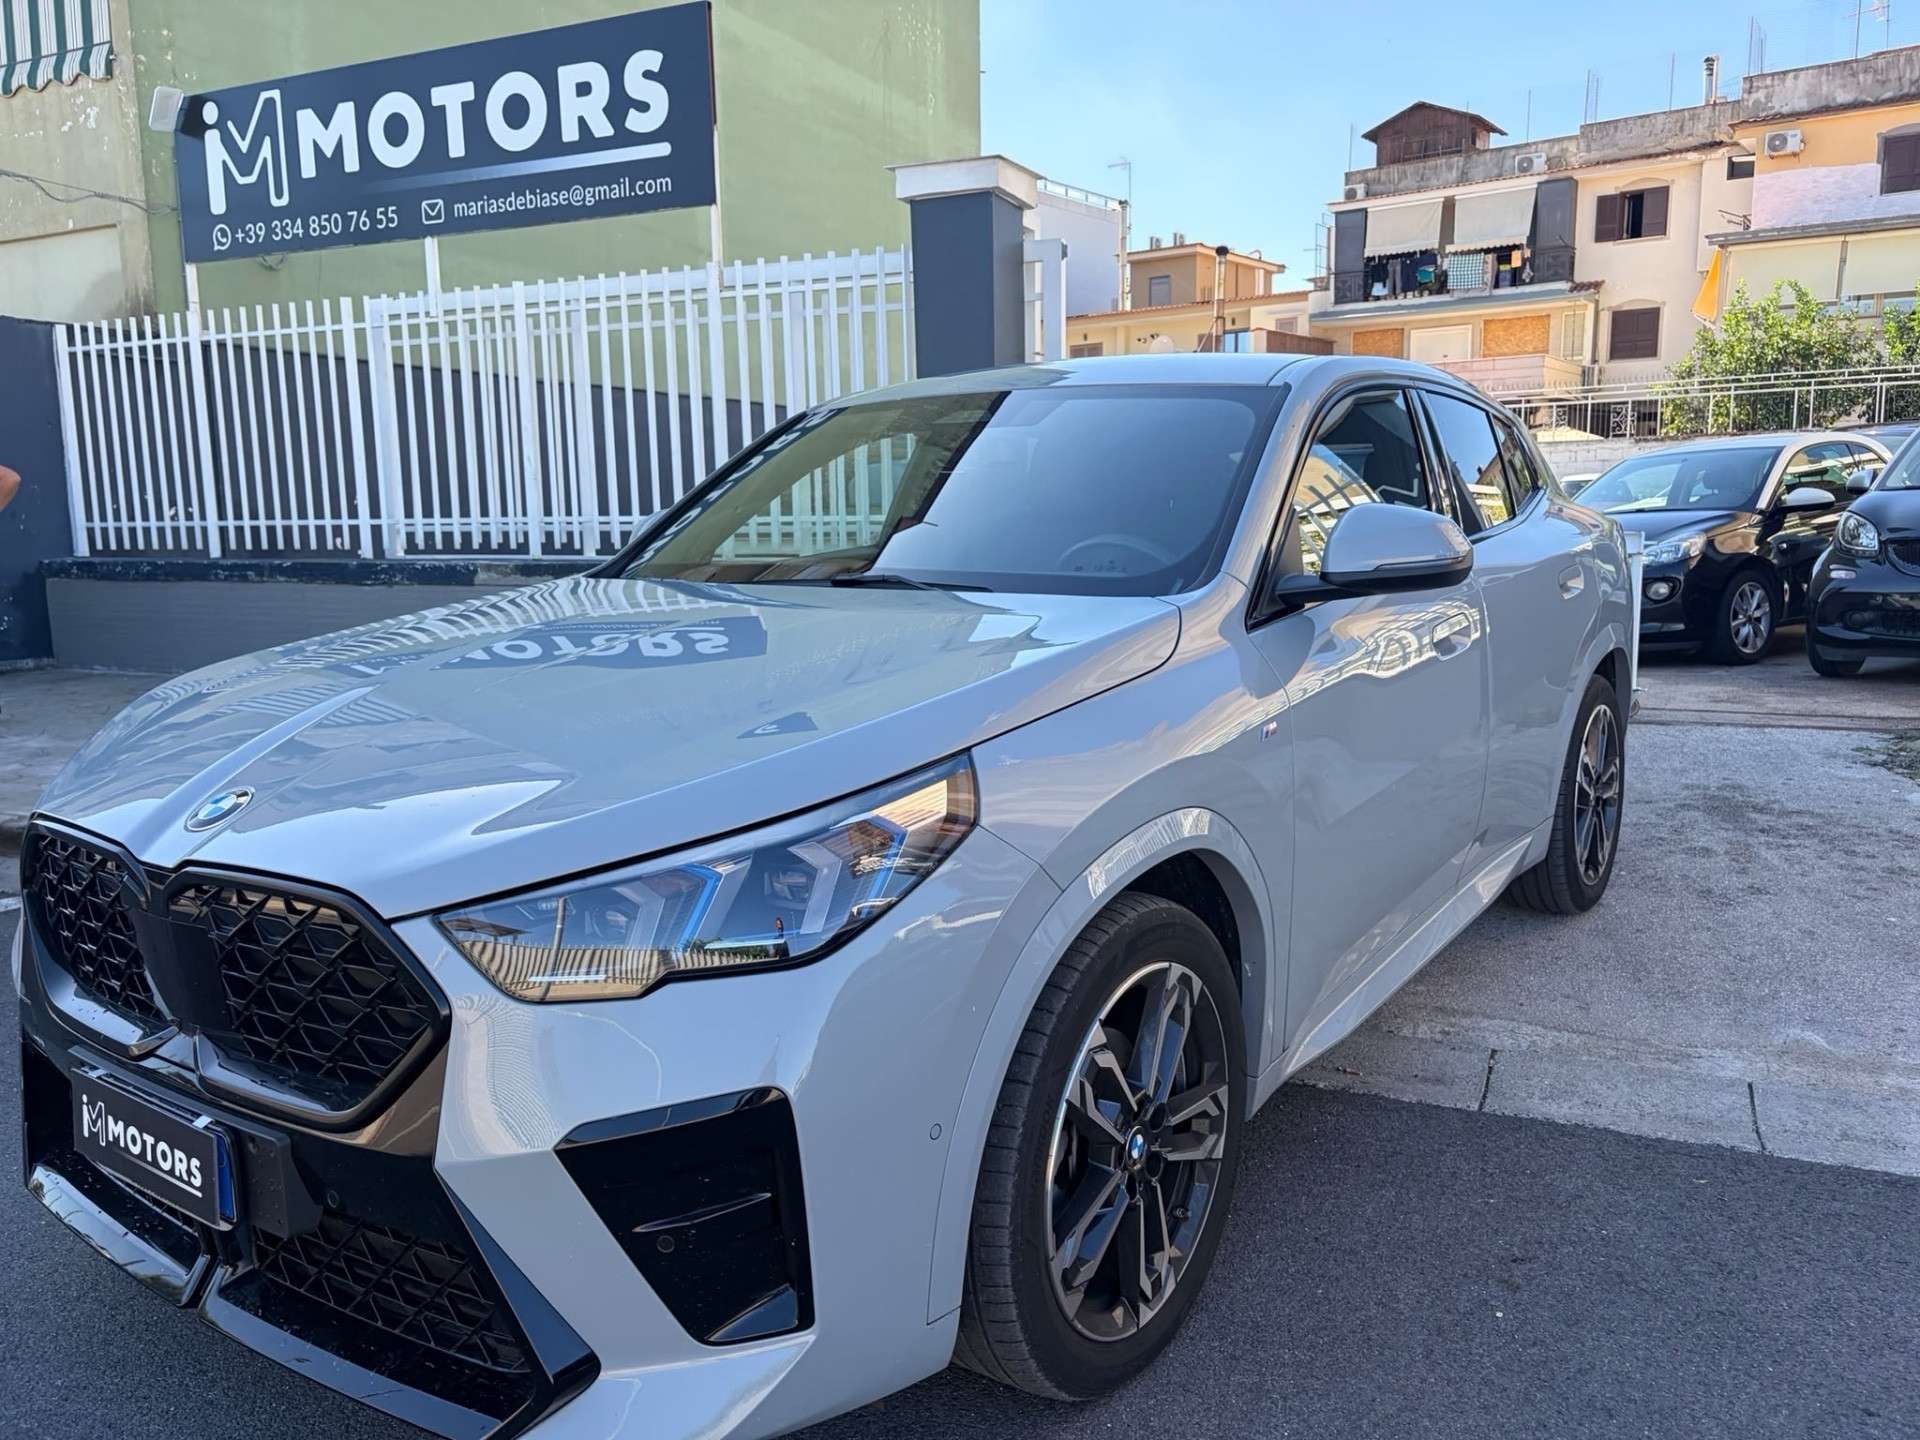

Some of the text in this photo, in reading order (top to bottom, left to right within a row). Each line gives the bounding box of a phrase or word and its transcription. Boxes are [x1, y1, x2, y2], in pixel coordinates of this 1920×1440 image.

[296, 49, 670, 179] MOTORS
[235, 206, 398, 244] +39 334 850 76 55
[453, 176, 672, 218] mariasdebiase@gmail.com
[107, 1115, 203, 1188] MOTORS
